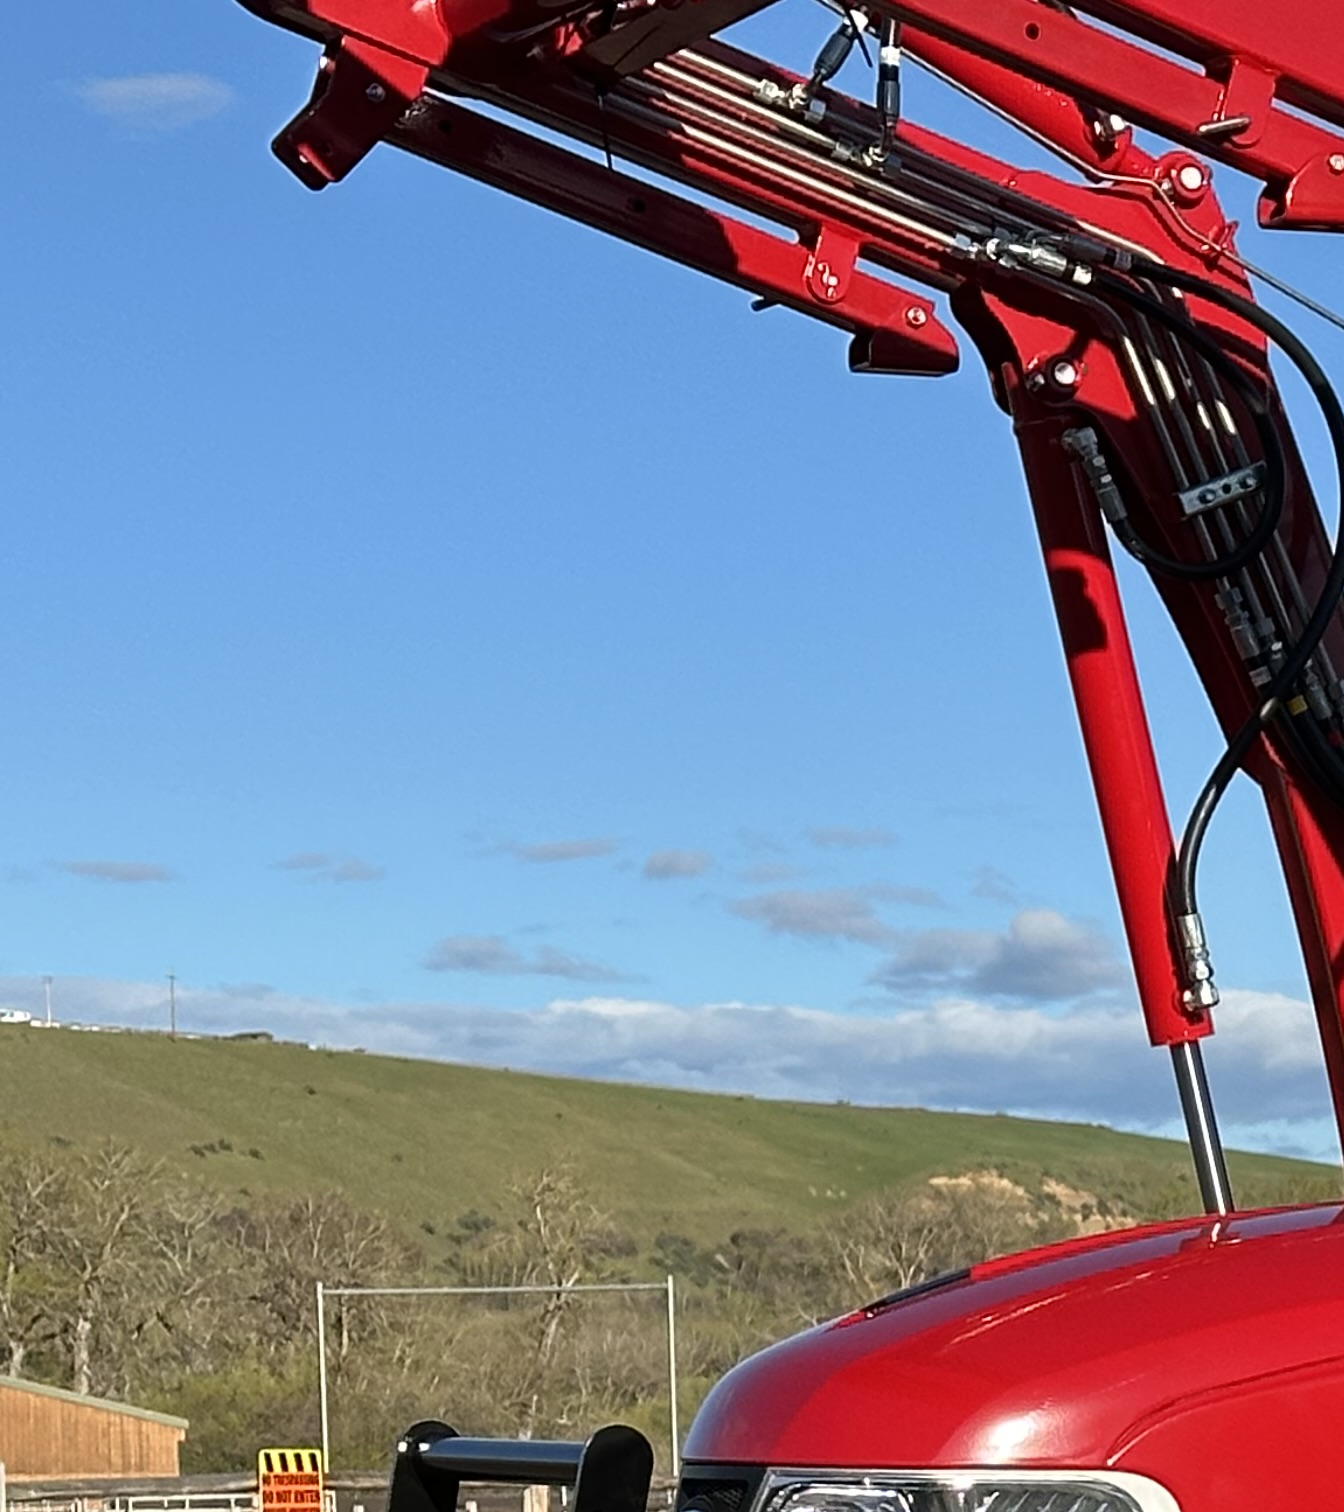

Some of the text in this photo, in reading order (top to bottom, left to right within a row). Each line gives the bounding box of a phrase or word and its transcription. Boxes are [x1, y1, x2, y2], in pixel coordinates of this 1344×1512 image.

[263, 1490, 320, 1503] DO NOT ENTER
